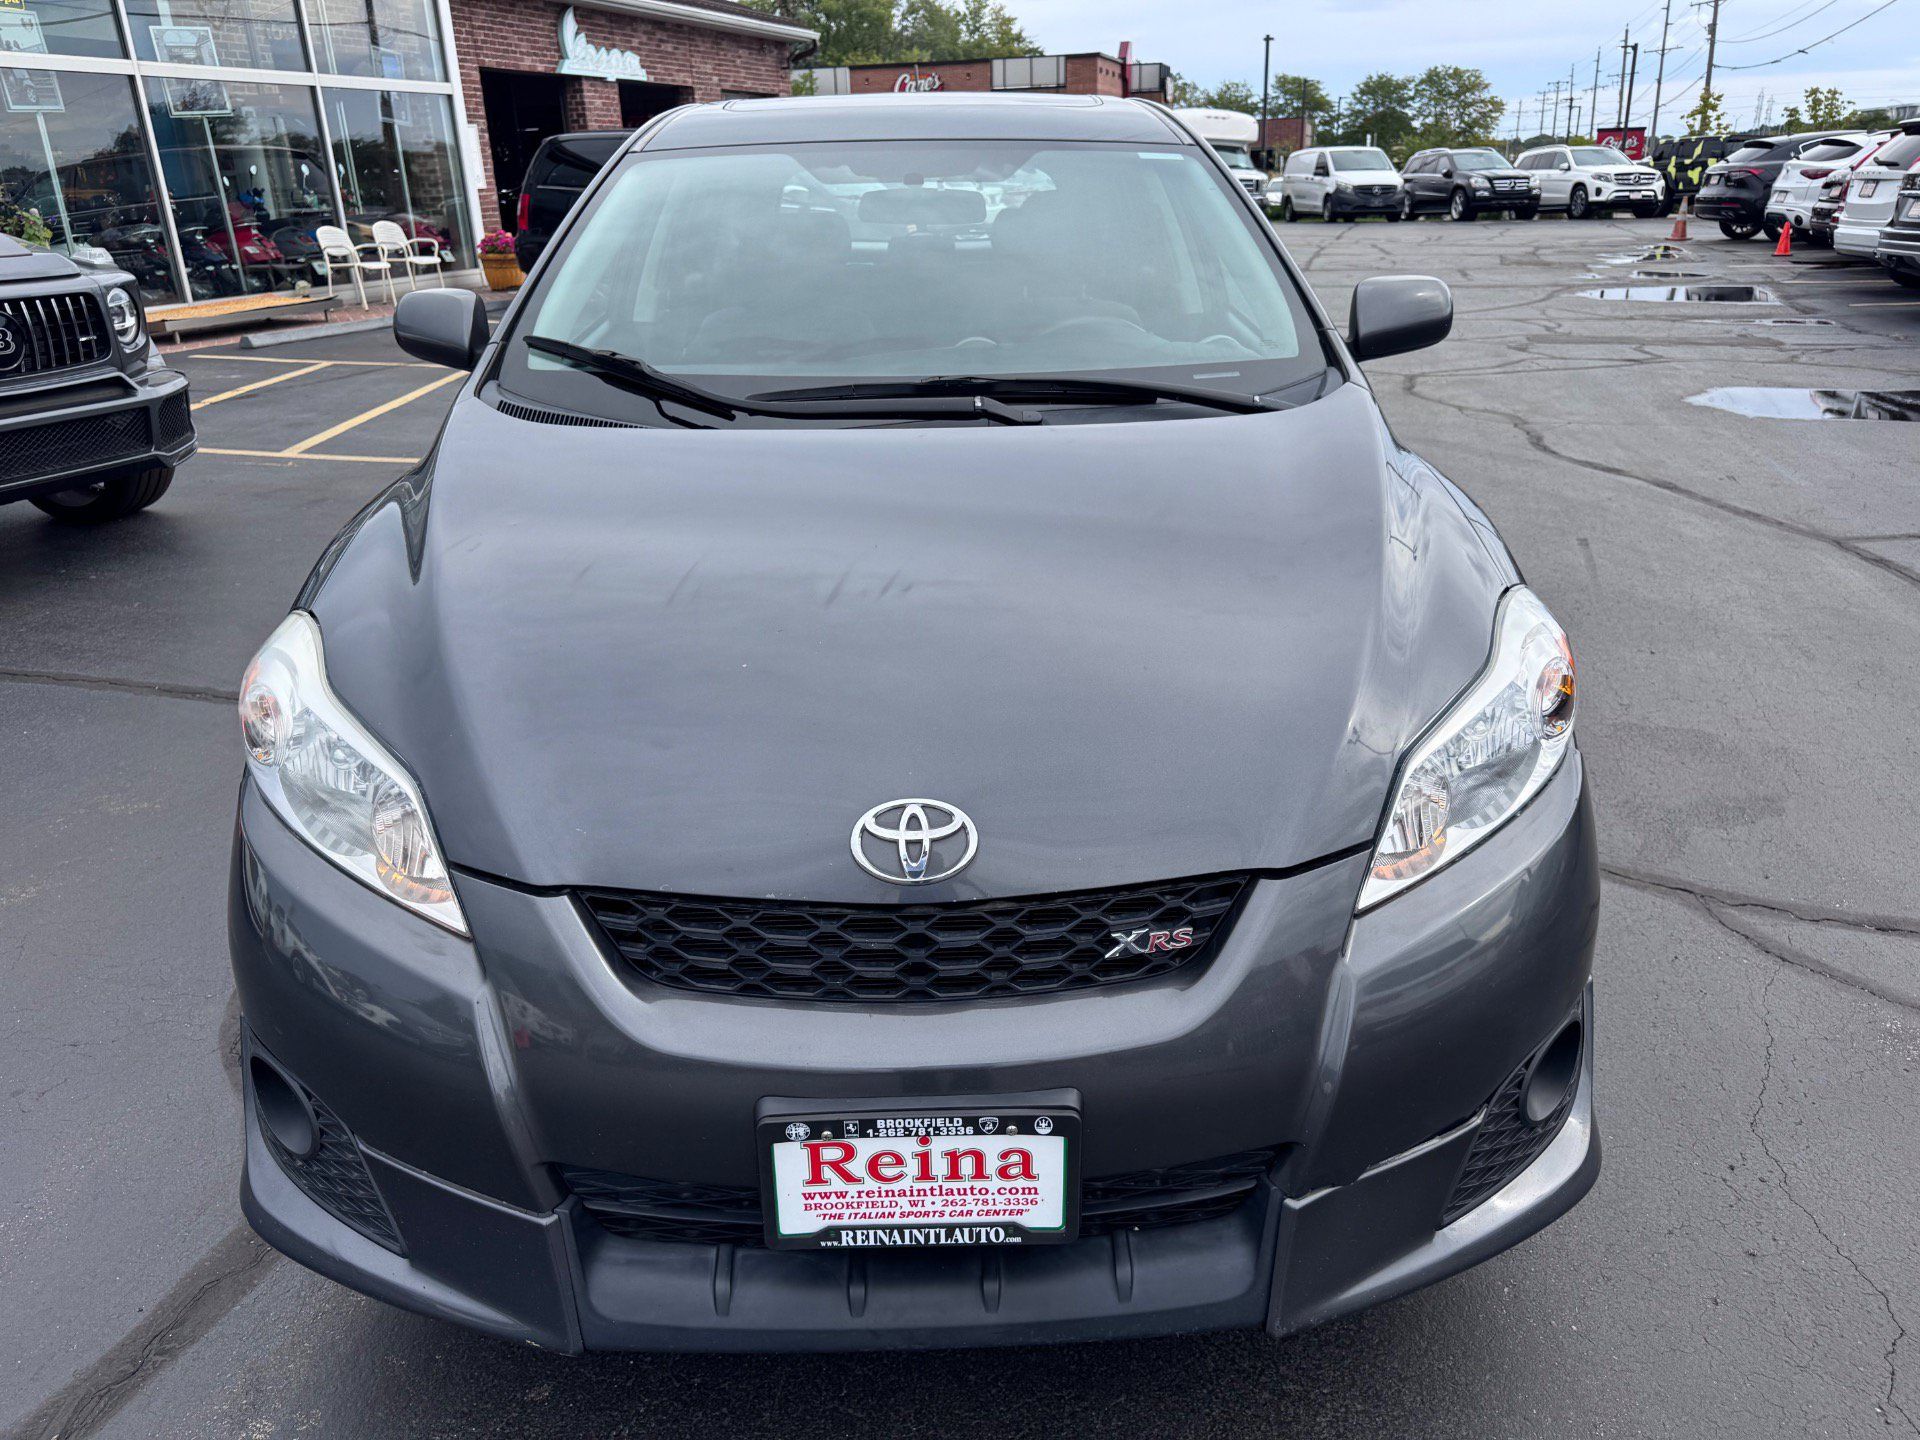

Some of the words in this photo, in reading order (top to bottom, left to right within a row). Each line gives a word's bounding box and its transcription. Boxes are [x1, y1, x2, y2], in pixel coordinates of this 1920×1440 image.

[1104, 927, 1194, 958] XRS
[876, 1117, 963, 1129] BROOKFIELD
[866, 1126, 974, 1138] 1-262-781-3336
[800, 1135, 1040, 1187] Reina
[801, 1184, 1039, 1201] www.reinaintlauto.com
[803, 1200, 903, 1212] BROOKFIELD,
[907, 1199, 926, 1209] WI
[940, 1197, 1039, 1208] 262-781-3336
[847, 1210, 896, 1220] ITALIAN
[899, 1209, 946, 1219] SPORTS
[948, 1208, 974, 1218] CAR
